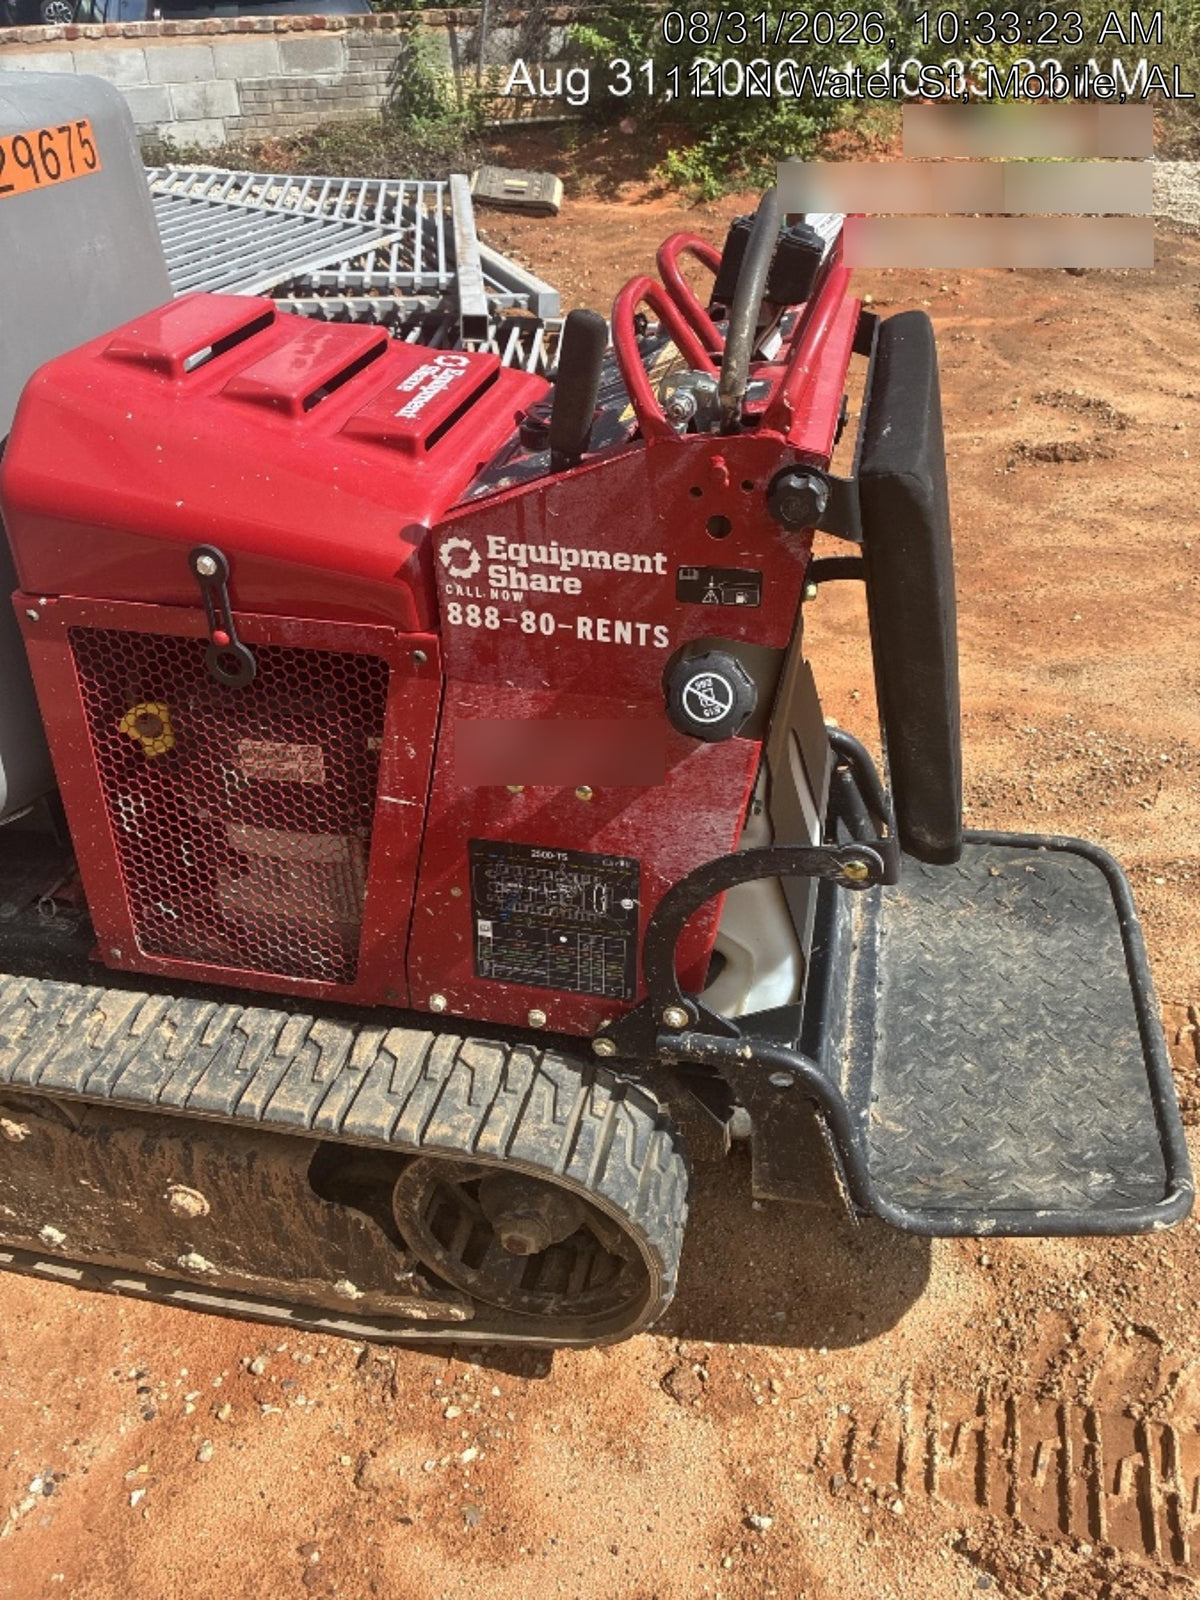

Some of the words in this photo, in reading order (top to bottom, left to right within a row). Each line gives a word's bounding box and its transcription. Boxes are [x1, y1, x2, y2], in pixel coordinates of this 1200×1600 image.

[486, 534, 668, 575] Equipment
[445, 583, 483, 599] CALL
[490, 588, 524, 603] NOW
[487, 564, 583, 595] Share
[447, 602, 670, 649] 888-80-RENTS
